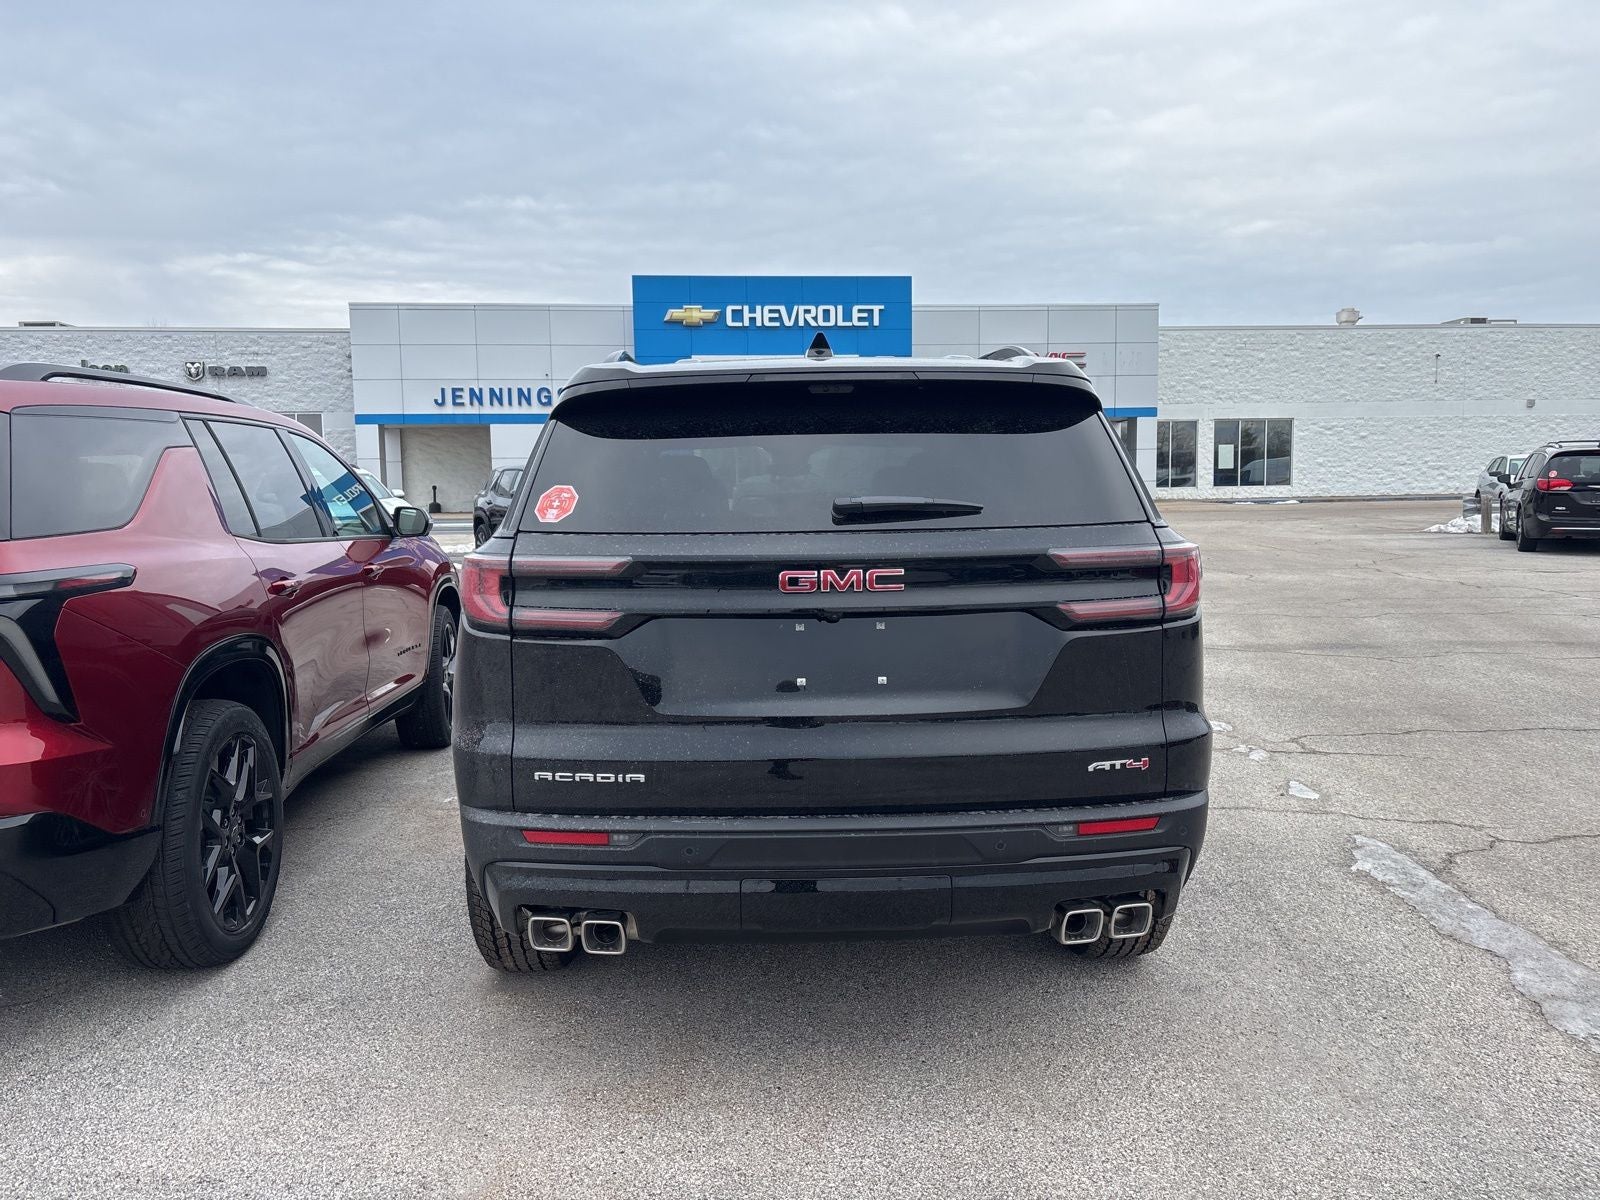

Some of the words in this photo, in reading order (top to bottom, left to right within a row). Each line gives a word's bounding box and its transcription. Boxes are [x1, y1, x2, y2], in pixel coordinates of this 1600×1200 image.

[725, 304, 885, 328] CHEVROLET
[208, 365, 267, 377] RAM
[433, 386, 563, 407] JENNING
[778, 568, 905, 593] GMC
[1087, 757, 1149, 772] AT4
[533, 771, 646, 783] ACADIA
